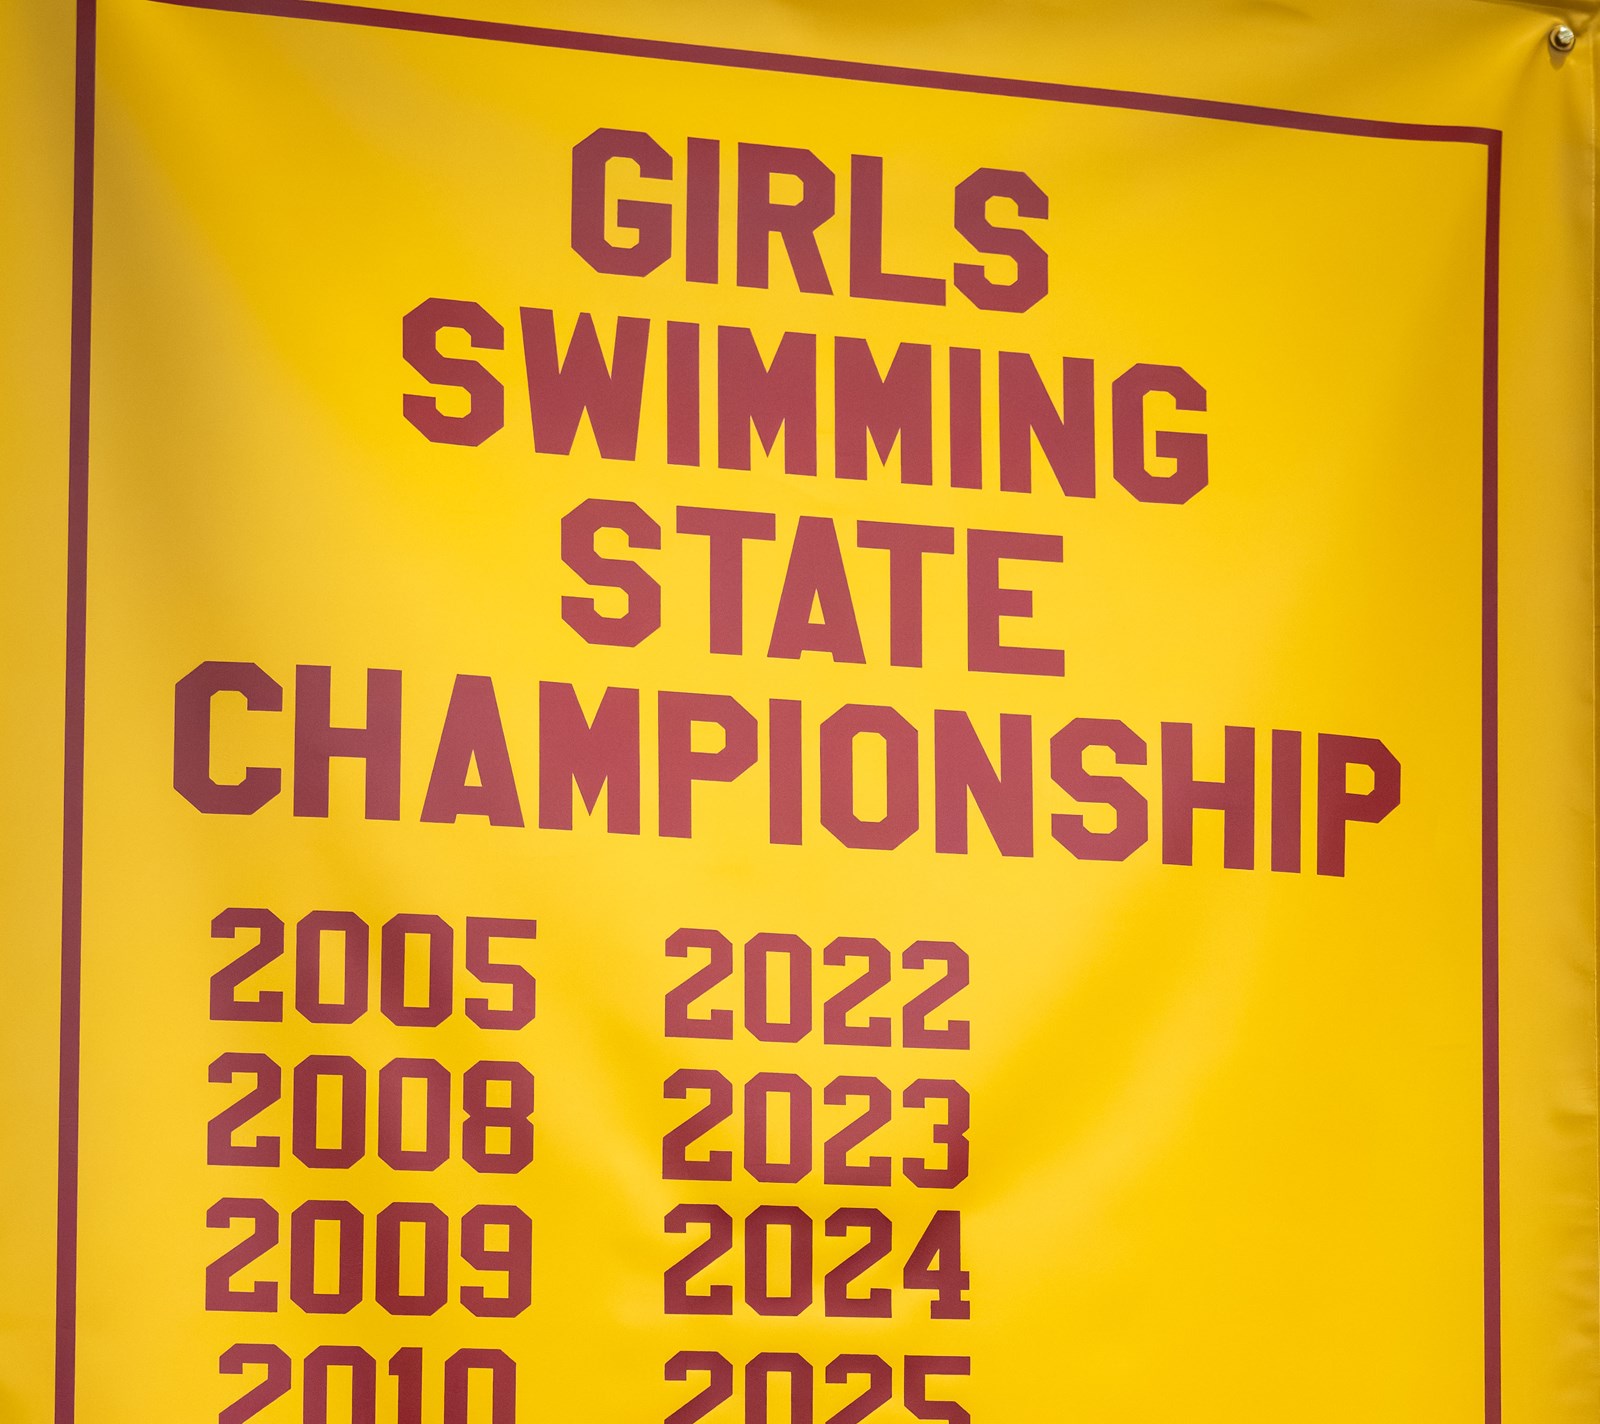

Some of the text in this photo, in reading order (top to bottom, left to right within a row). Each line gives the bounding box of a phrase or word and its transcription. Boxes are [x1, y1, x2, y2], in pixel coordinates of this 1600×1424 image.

[571, 128, 1049, 313] GIRLS
[403, 298, 1208, 504] SWIMMING
[561, 499, 1065, 677] STATE
[173, 661, 1401, 877] CHAMPIONSHIP
[209, 907, 537, 1031] 2005
[665, 928, 970, 1050] 2022
[207, 1052, 534, 1174] 2008
[662, 1069, 970, 1189] 2023
[205, 1197, 532, 1317] 2009
[664, 1204, 970, 1320] 2024
